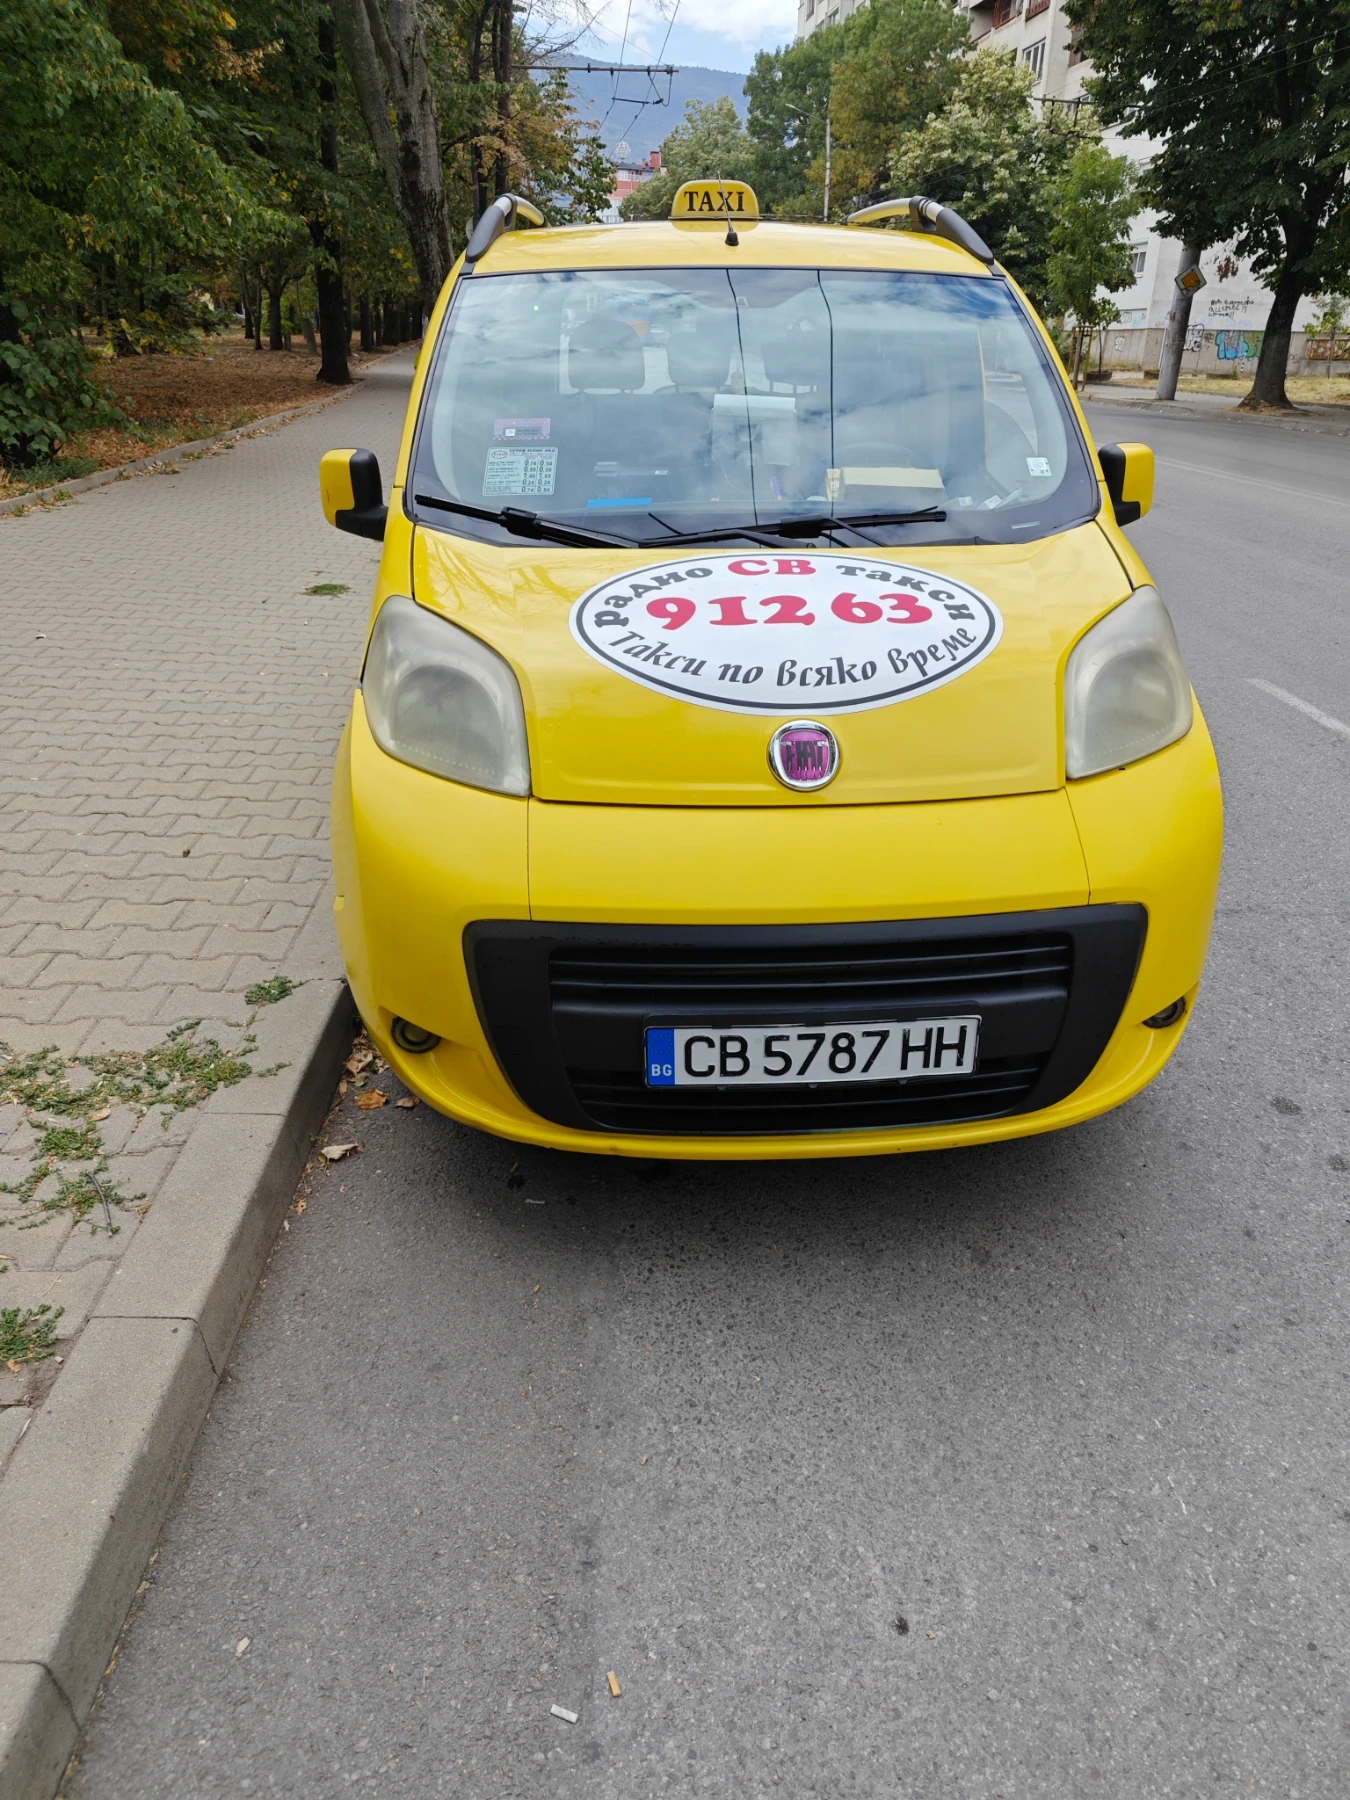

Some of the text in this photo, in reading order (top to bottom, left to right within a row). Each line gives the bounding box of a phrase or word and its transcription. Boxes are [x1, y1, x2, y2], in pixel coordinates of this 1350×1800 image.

[684, 191, 745, 212] TAXI
[594, 567, 714, 628] радио
[836, 565, 976, 621] такси
[608, 630, 708, 676] Такси
[717, 663, 764, 684] по
[651, 1063, 672, 1077] BG
